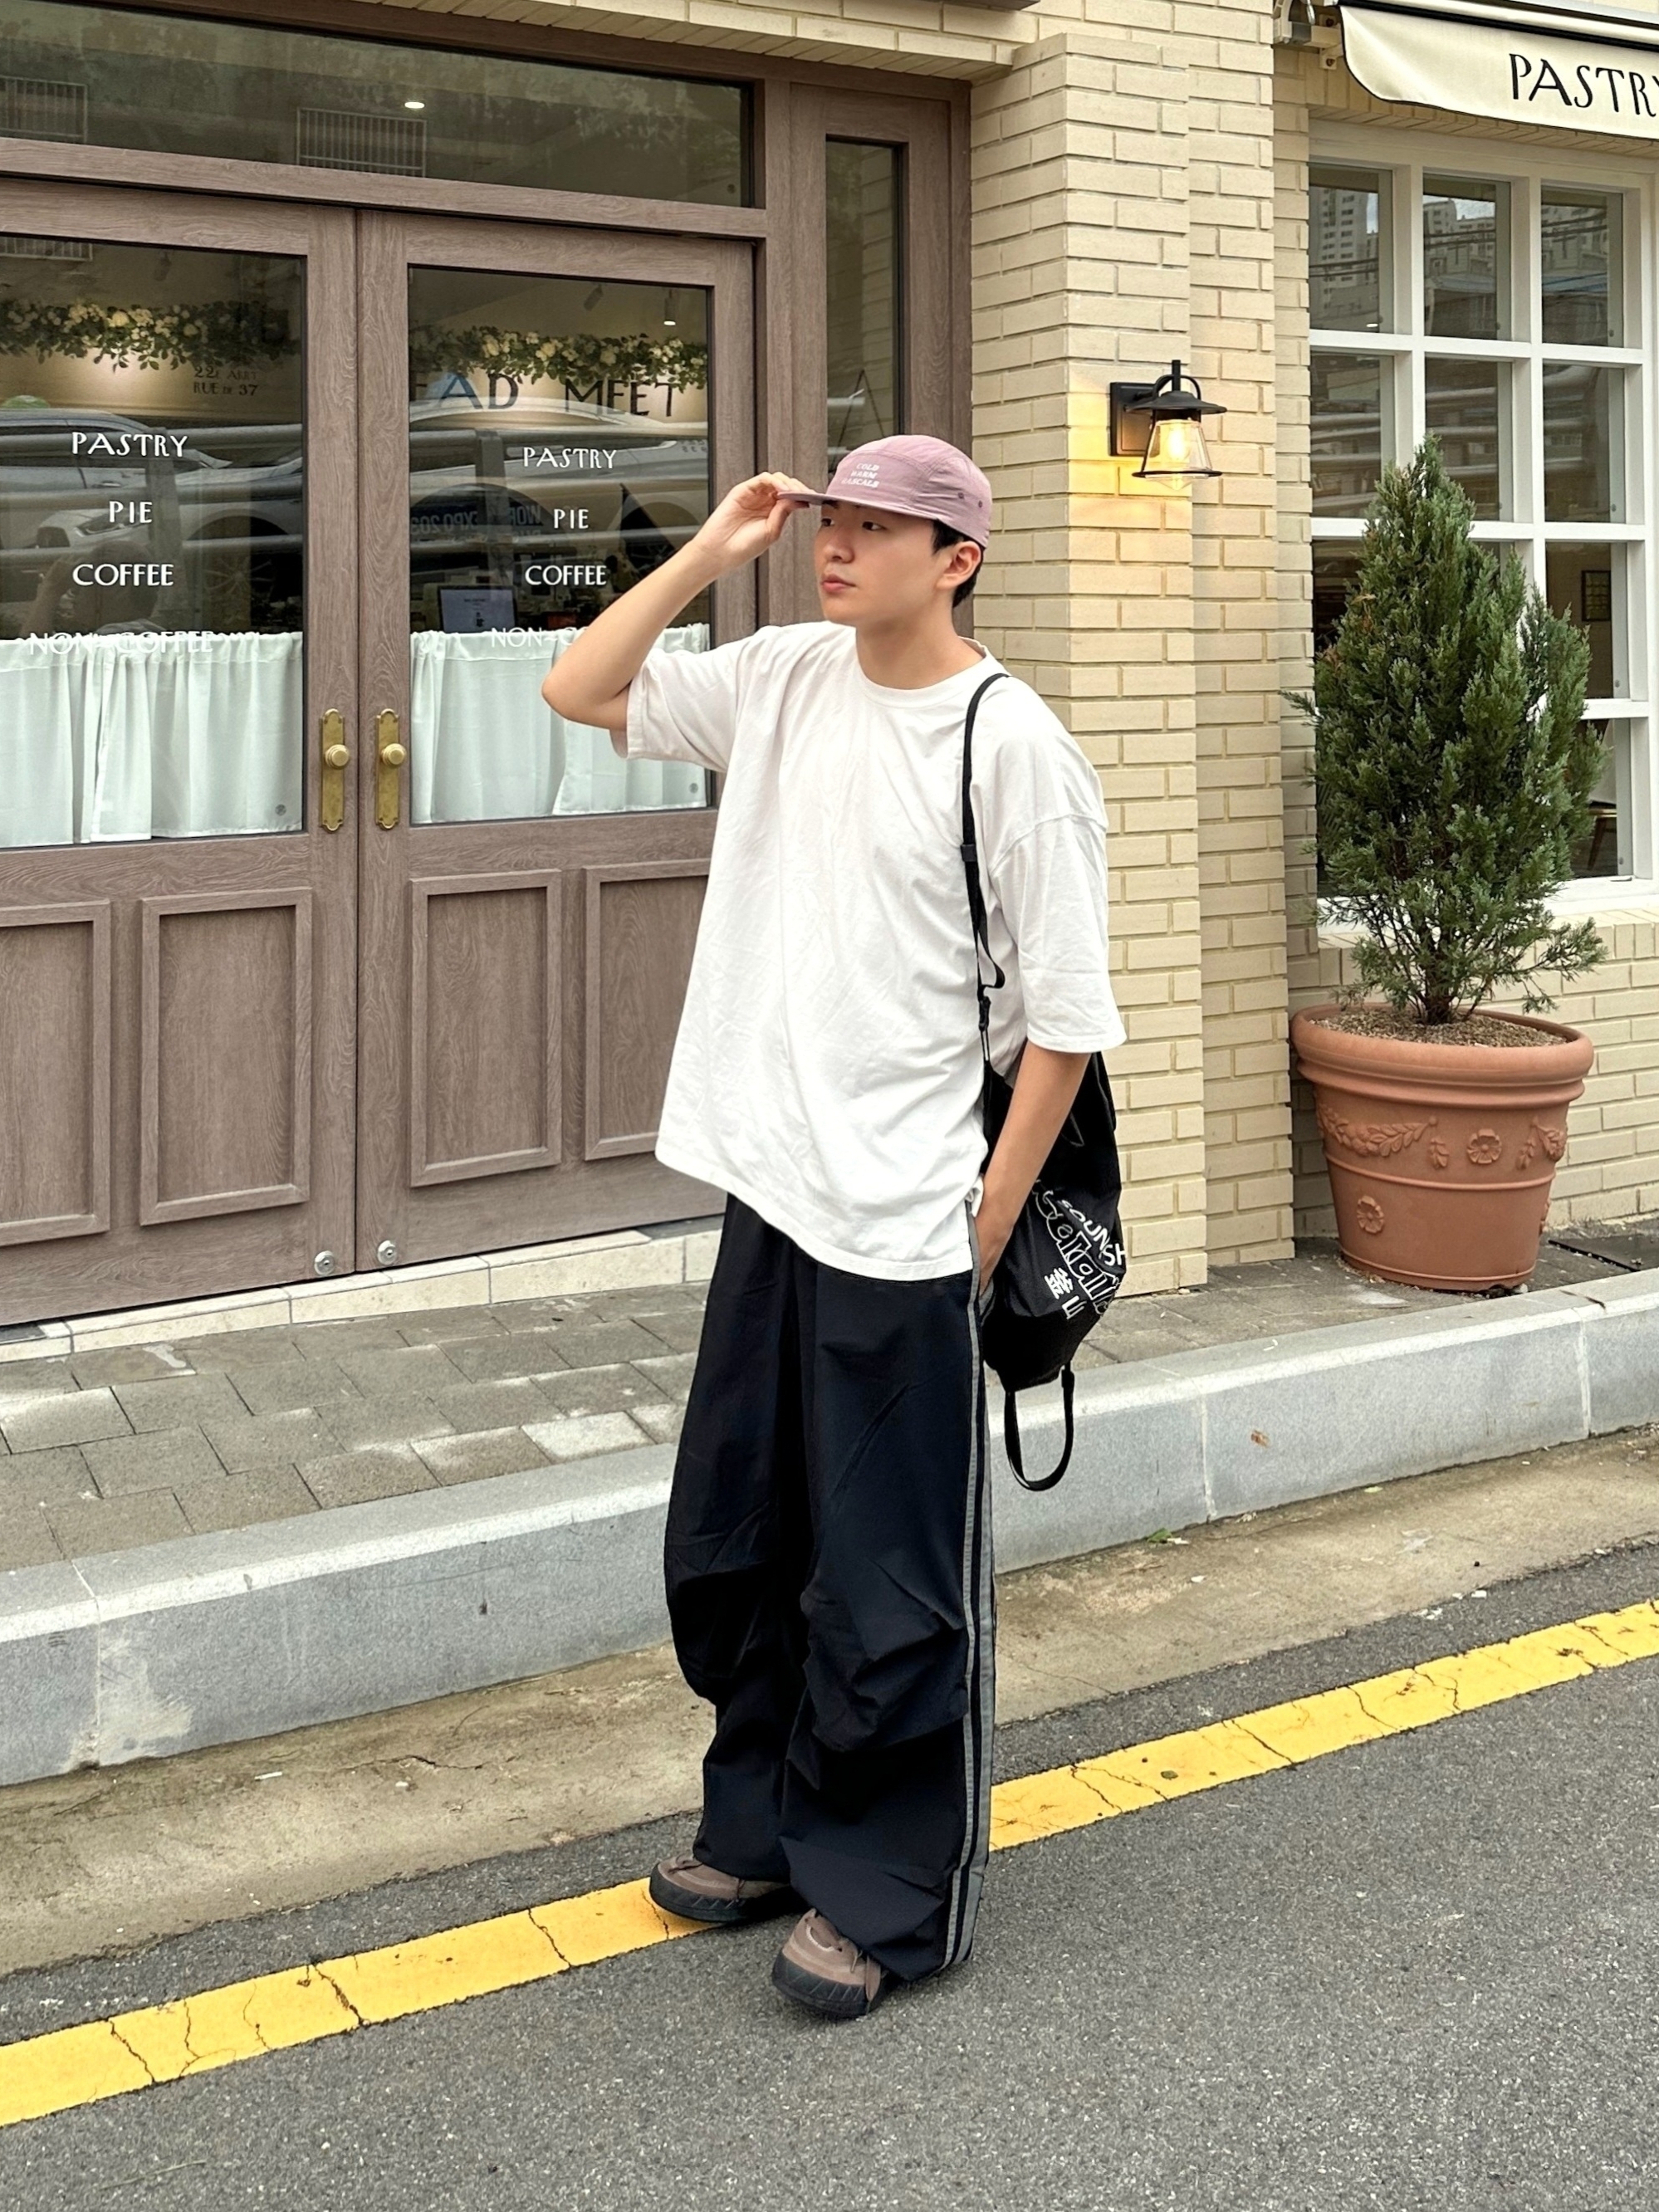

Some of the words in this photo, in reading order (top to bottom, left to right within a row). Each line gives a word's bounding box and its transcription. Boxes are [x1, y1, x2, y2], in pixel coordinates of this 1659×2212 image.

[193, 382, 219, 394] RUE
[238, 384, 259, 396] 37
[71, 432, 188, 458] PASTRY
[523, 447, 617, 469] PASTRY
[856, 462, 880, 471] COLD
[109, 501, 153, 524] PIE
[553, 508, 589, 529] PIE
[72, 564, 174, 587] COFFEE
[525, 565, 607, 586] COFFEE
